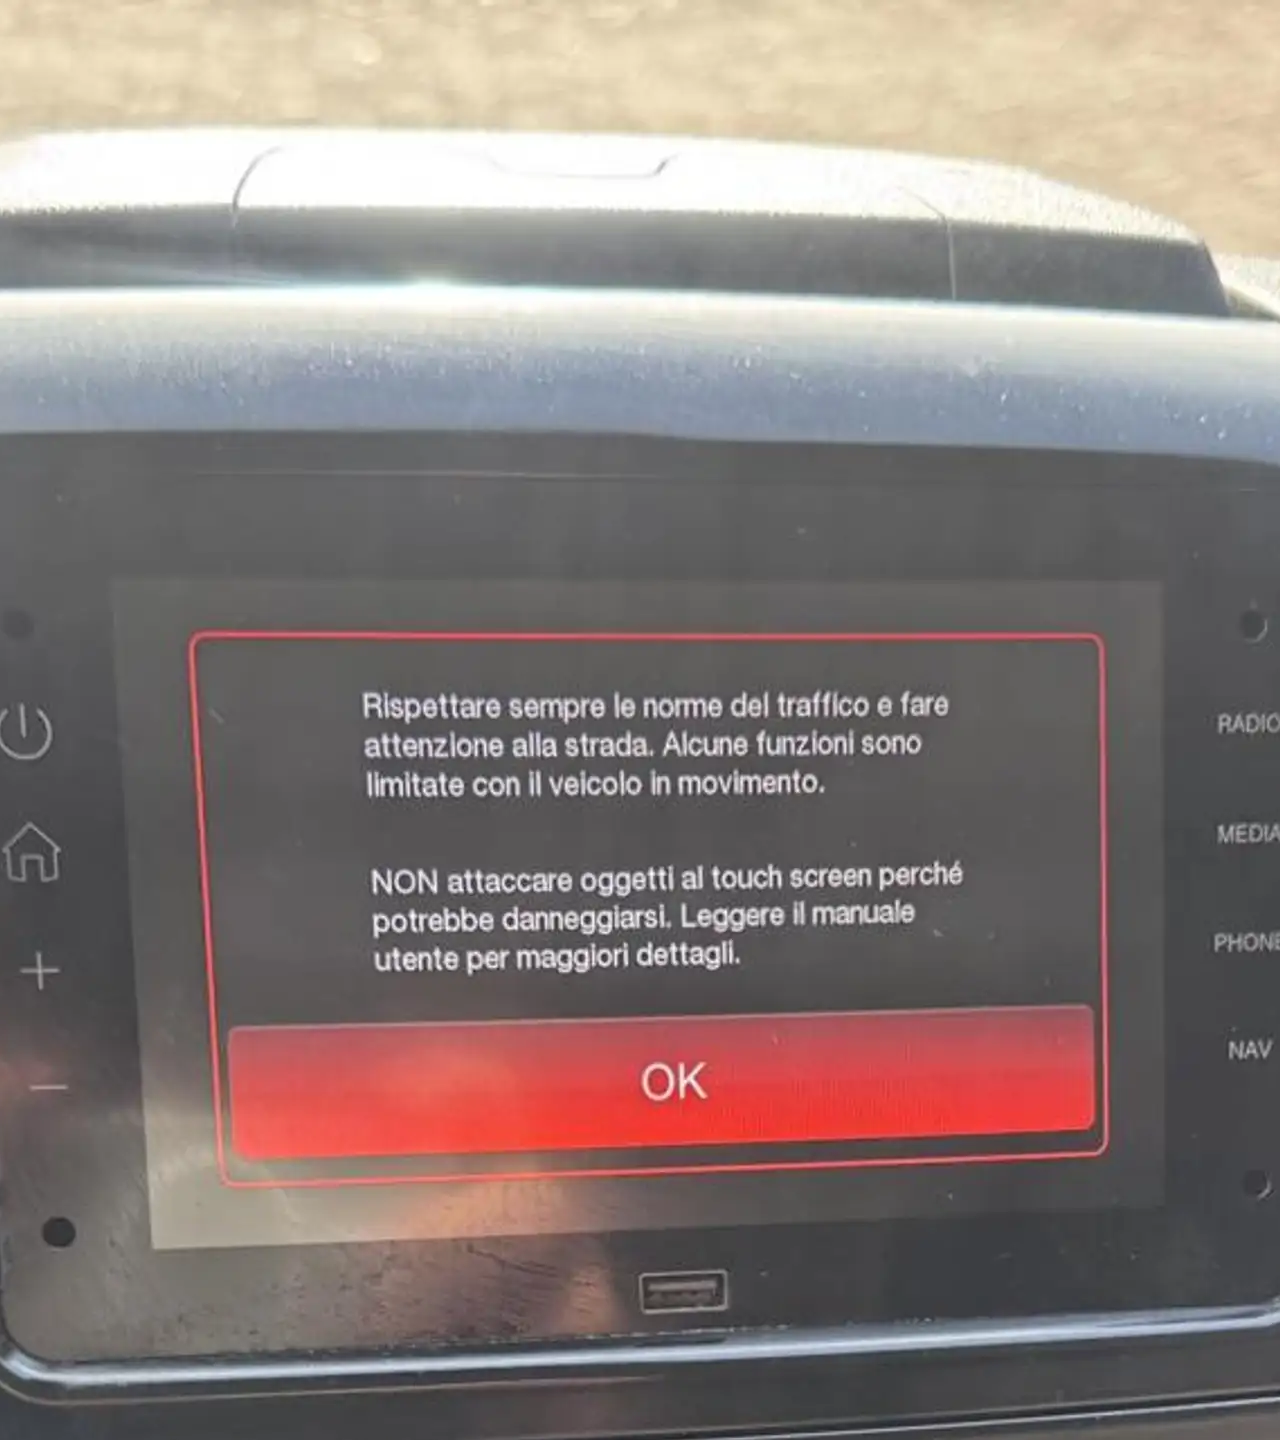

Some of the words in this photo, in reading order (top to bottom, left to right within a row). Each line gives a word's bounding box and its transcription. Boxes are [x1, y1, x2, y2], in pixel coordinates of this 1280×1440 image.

[362, 692, 502, 724] Rispettare
[509, 695, 606, 723] sempre
[614, 692, 636, 719] le
[643, 695, 723, 718] norme
[731, 692, 769, 718] del
[777, 690, 870, 718] traffico
[877, 695, 893, 717] e
[899, 691, 950, 717] fare
[364, 731, 505, 758] attenzione
[512, 731, 558, 758] alla
[565, 730, 654, 757] strada.
[662, 730, 749, 757] Alcune
[756, 729, 855, 756] funzioni
[861, 733, 922, 755] sono
[367, 770, 465, 797] limitate
[472, 774, 521, 797] con
[528, 770, 542, 796] il
[548, 769, 643, 796] veicolo
[650, 769, 671, 796] in
[678, 769, 825, 795] movimento.
[371, 868, 438, 896] NON
[447, 869, 573, 894] attaccare
[579, 866, 675, 897] oggetti
[681, 865, 703, 889] al
[711, 864, 782, 890] touch
[789, 867, 872, 888] screen
[878, 860, 963, 891] perché
[372, 906, 495, 938] potrebbe
[502, 904, 672, 935] danneggiarsi.
[680, 902, 785, 933] Leggere
[792, 901, 805, 926] il
[812, 900, 915, 926] manuale
[374, 946, 460, 972] utente
[467, 950, 510, 975] per
[516, 943, 630, 973] maggiori
[636, 940, 740, 972] dettagli.
[1228, 1040, 1272, 1060] NAV
[641, 1062, 708, 1102] OK
